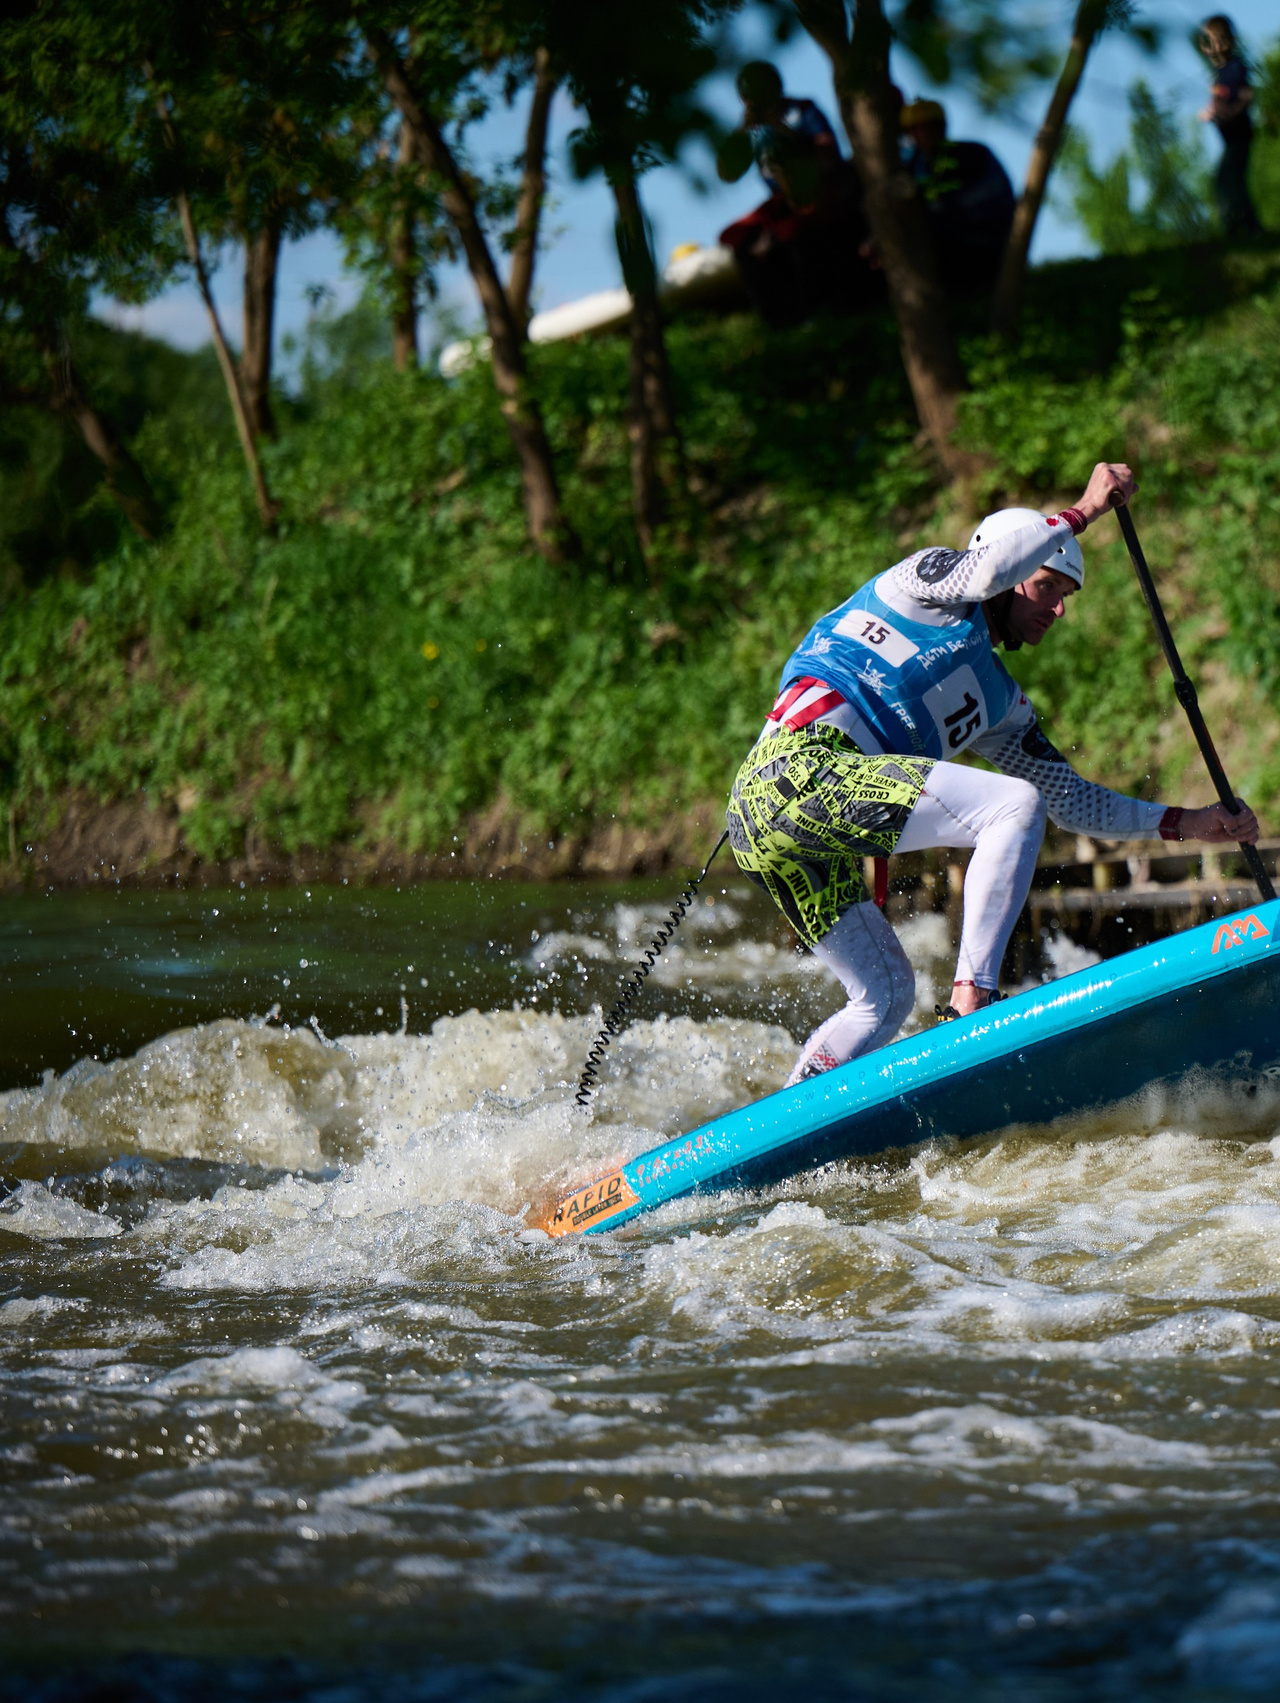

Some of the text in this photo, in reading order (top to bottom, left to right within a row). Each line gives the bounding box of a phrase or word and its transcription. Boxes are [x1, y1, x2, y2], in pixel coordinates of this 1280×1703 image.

[860, 620, 891, 645] 15
[916, 645, 949, 671] Дети
[944, 691, 982, 749] 15
[858, 789, 890, 801] CROSS
[795, 813, 817, 832] LINE
[786, 868, 811, 903] LINE
[553, 1176, 621, 1226] RAPID
